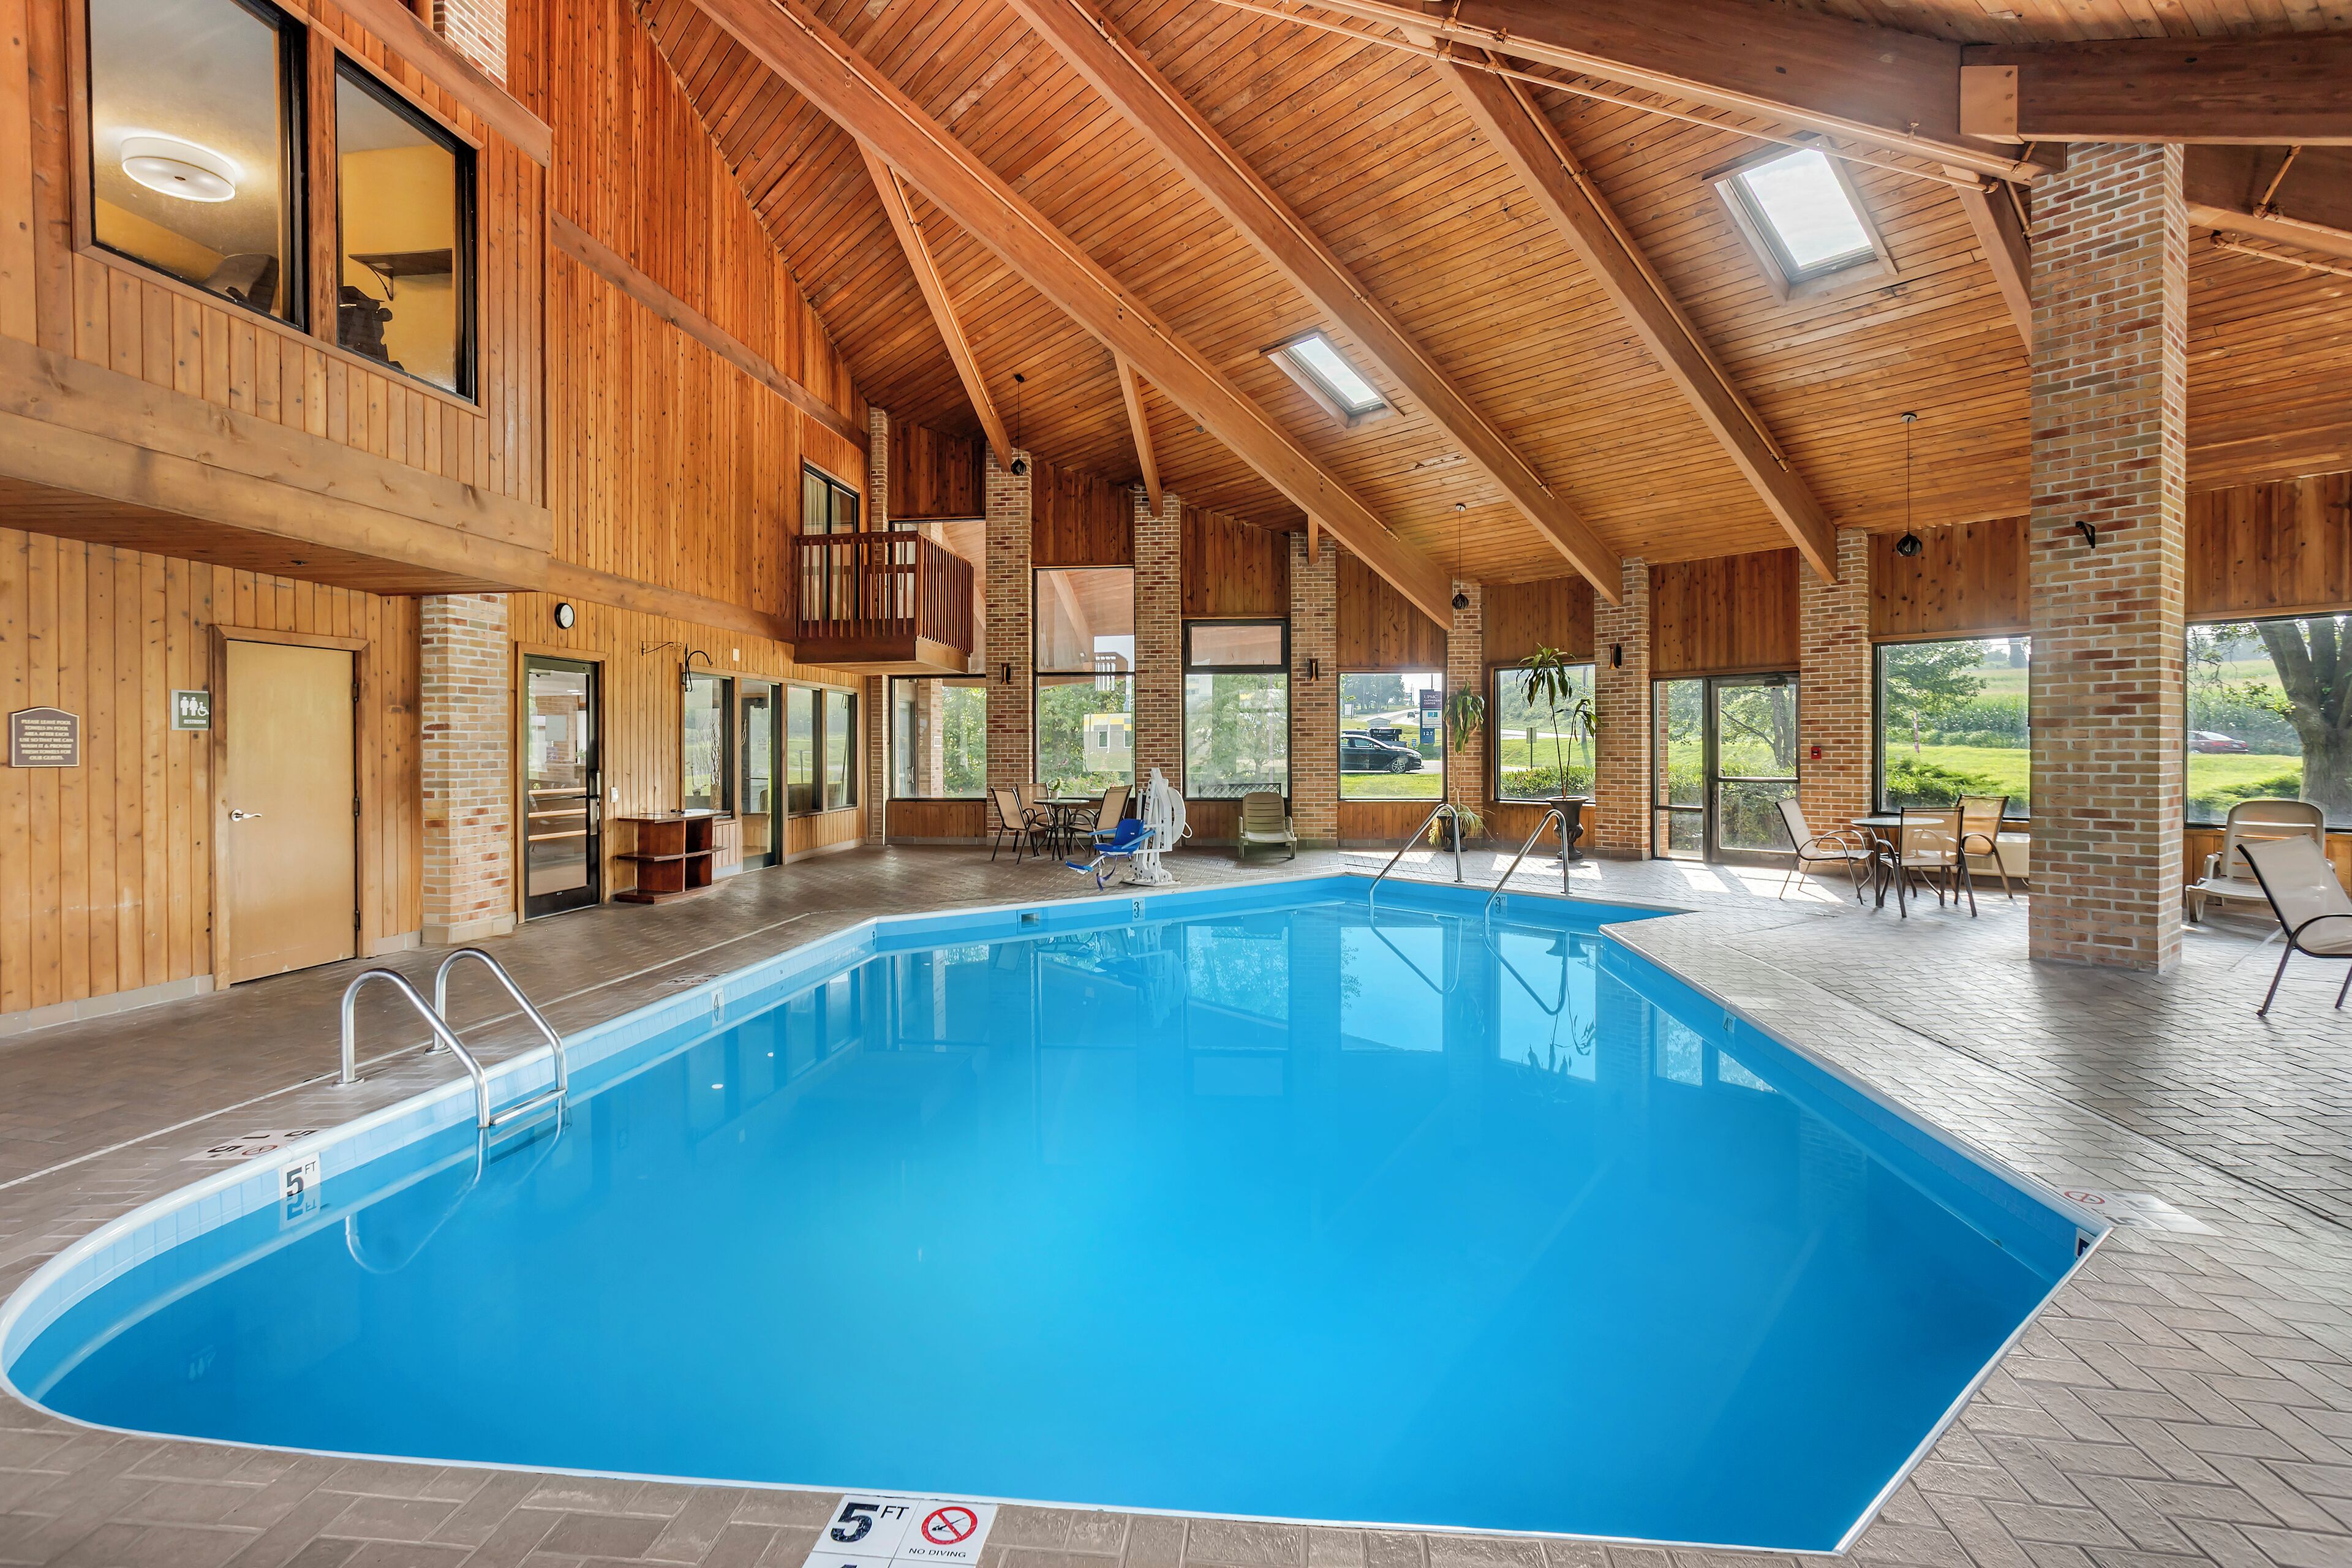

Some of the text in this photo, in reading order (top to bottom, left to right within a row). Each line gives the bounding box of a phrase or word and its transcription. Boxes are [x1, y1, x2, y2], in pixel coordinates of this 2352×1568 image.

[1134, 901, 1139, 911] 3
[713, 993, 720, 1009] 4
[1722, 1017, 1729, 1031] 4
[286, 1161, 317, 1197] 5 FT
[830, 1501, 910, 1543] 5 FT
[927, 1548, 967, 1558] DIVING
